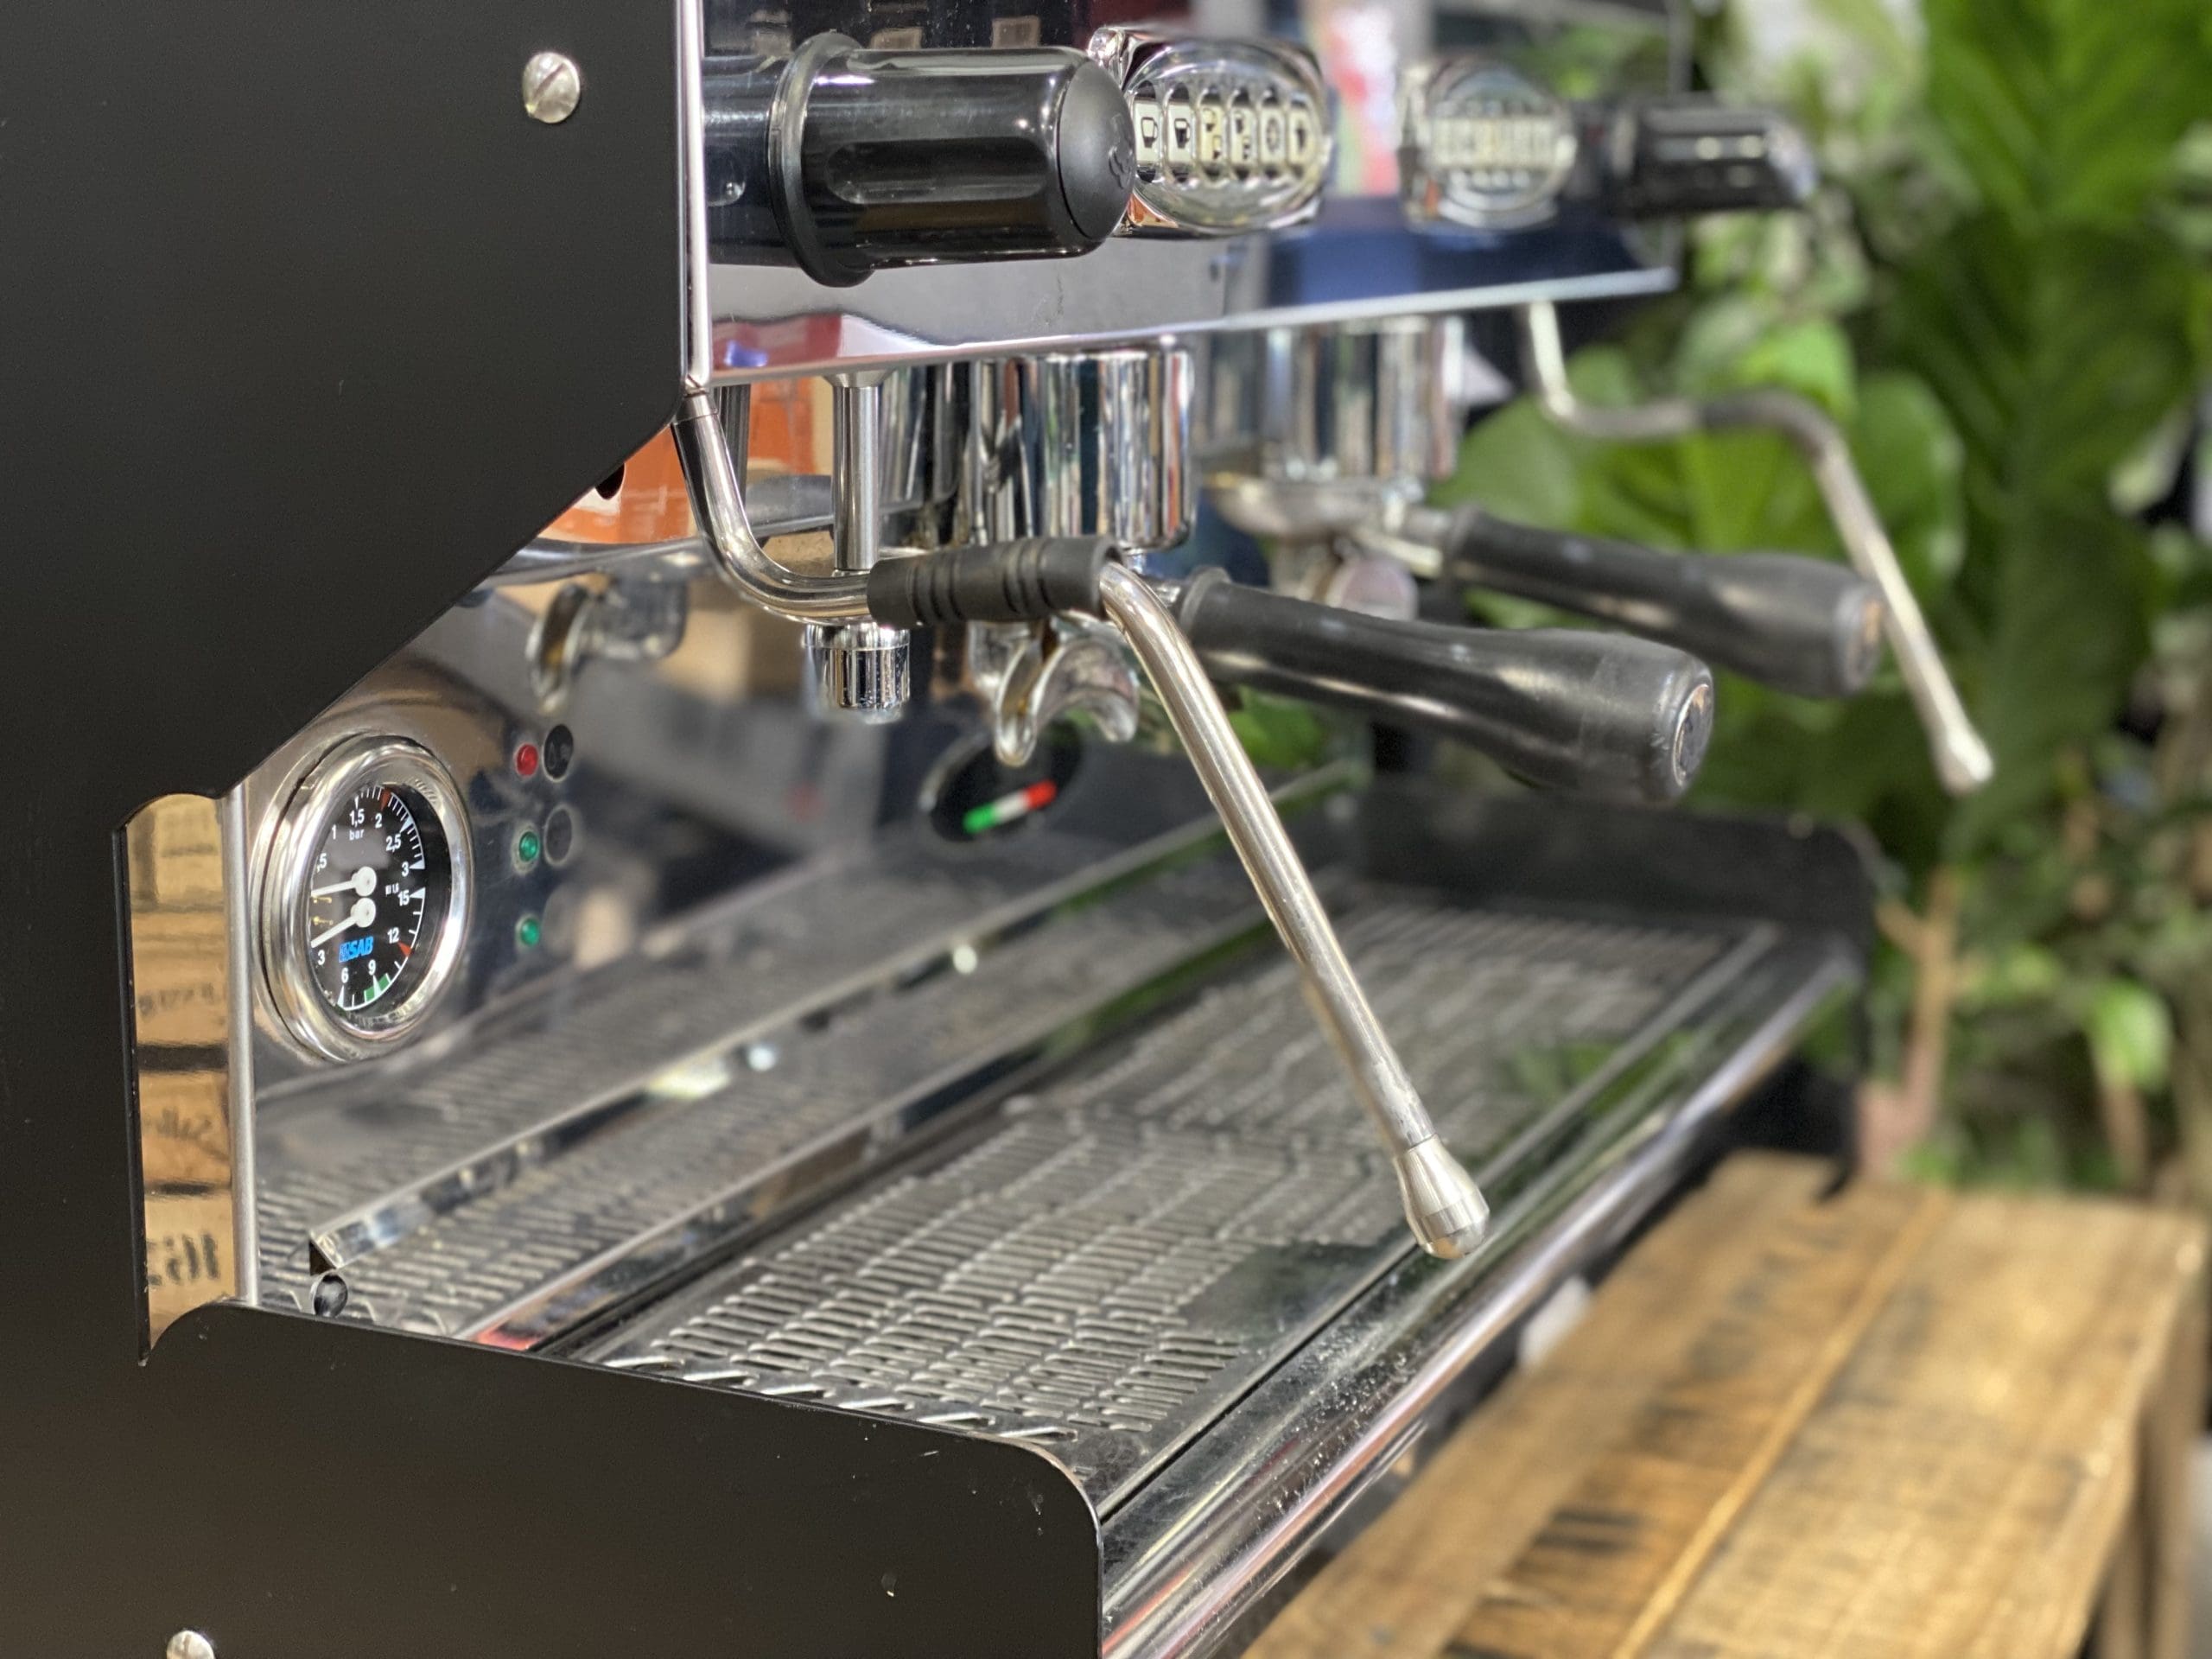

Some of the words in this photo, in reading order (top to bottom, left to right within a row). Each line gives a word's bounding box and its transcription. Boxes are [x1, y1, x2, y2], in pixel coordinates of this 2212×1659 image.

[349, 808, 365, 828] 1,5
[375, 812, 383, 829] 2
[332, 823, 337, 840] 1
[349, 829, 365, 841] bar
[385, 832, 402, 853] 2,5
[402, 861, 410, 877] 3
[397, 889, 410, 906] 15
[387, 926, 400, 944] 12
[317, 950, 326, 965] 3
[341, 967, 349, 983] 6
[368, 959, 377, 976] 9
